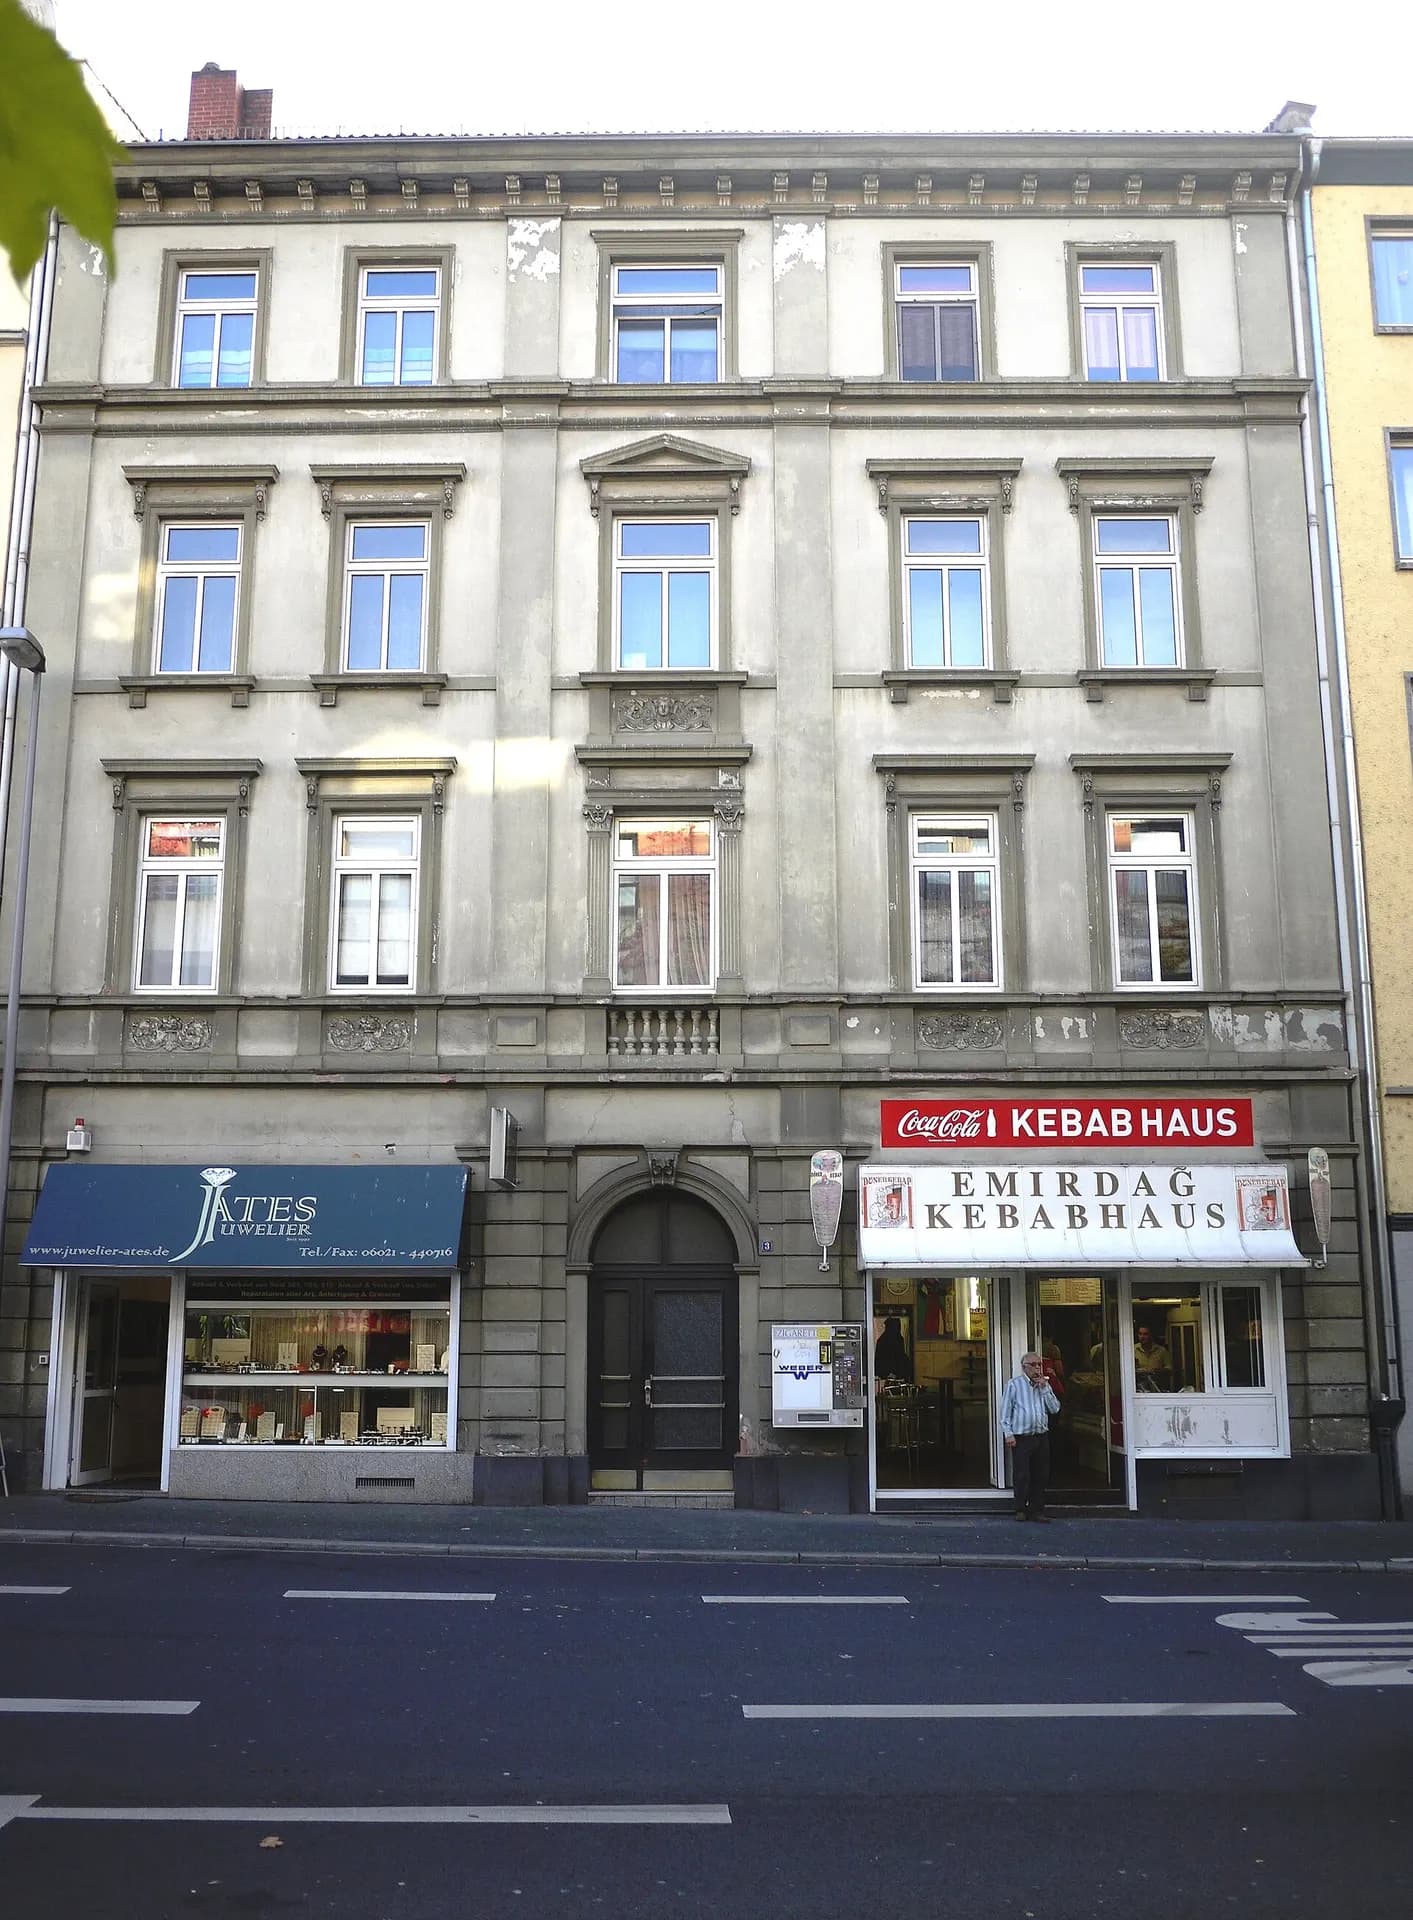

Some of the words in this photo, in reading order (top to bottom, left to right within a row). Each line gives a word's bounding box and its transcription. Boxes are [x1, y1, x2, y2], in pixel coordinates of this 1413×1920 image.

[897, 1109, 985, 1138] Coca-Cola
[1011, 1108, 1133, 1137] KEBAB
[1140, 1108, 1238, 1137] HAUS
[924, 1203, 1226, 1230] KEBABHAUS
[29, 1245, 170, 1259] www.juwelier-ates.de
[299, 1246, 358, 1257] Tel./Fax:
[361, 1248, 396, 1257] 06021
[409, 1247, 453, 1260] 440716
[764, 1241, 770, 1250] 3
